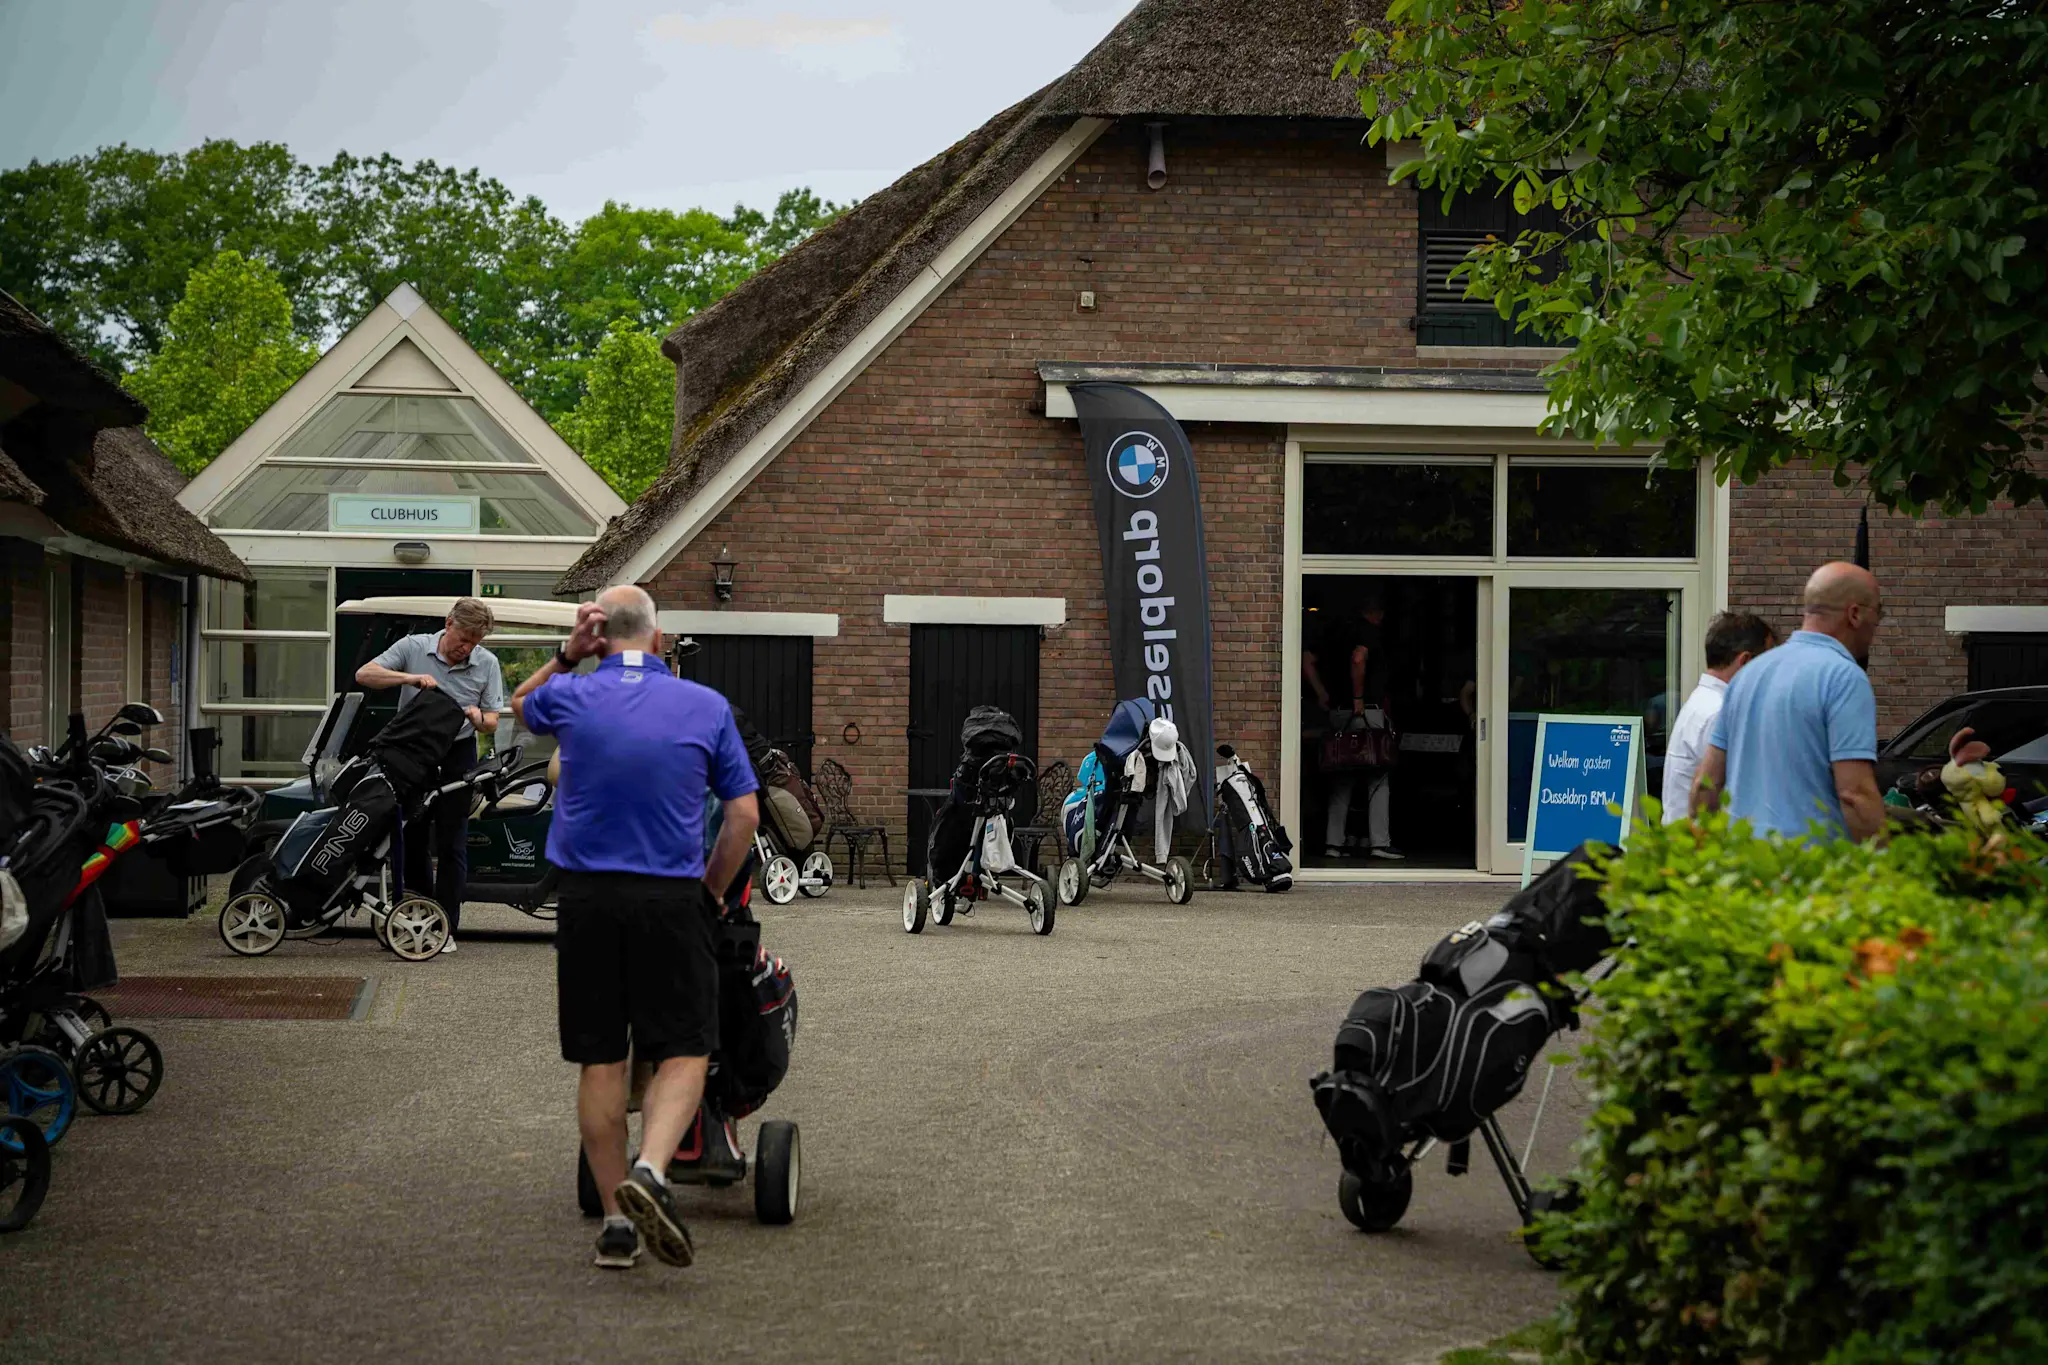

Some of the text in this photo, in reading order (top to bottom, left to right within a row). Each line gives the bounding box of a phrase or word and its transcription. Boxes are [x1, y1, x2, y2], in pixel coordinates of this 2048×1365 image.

[371, 507, 438, 521] CLUBHUIS
[1549, 751, 1611, 776] Welkom gasten
[1541, 788, 1616, 810] Dusseldorp BMW
[311, 808, 369, 876] PING
